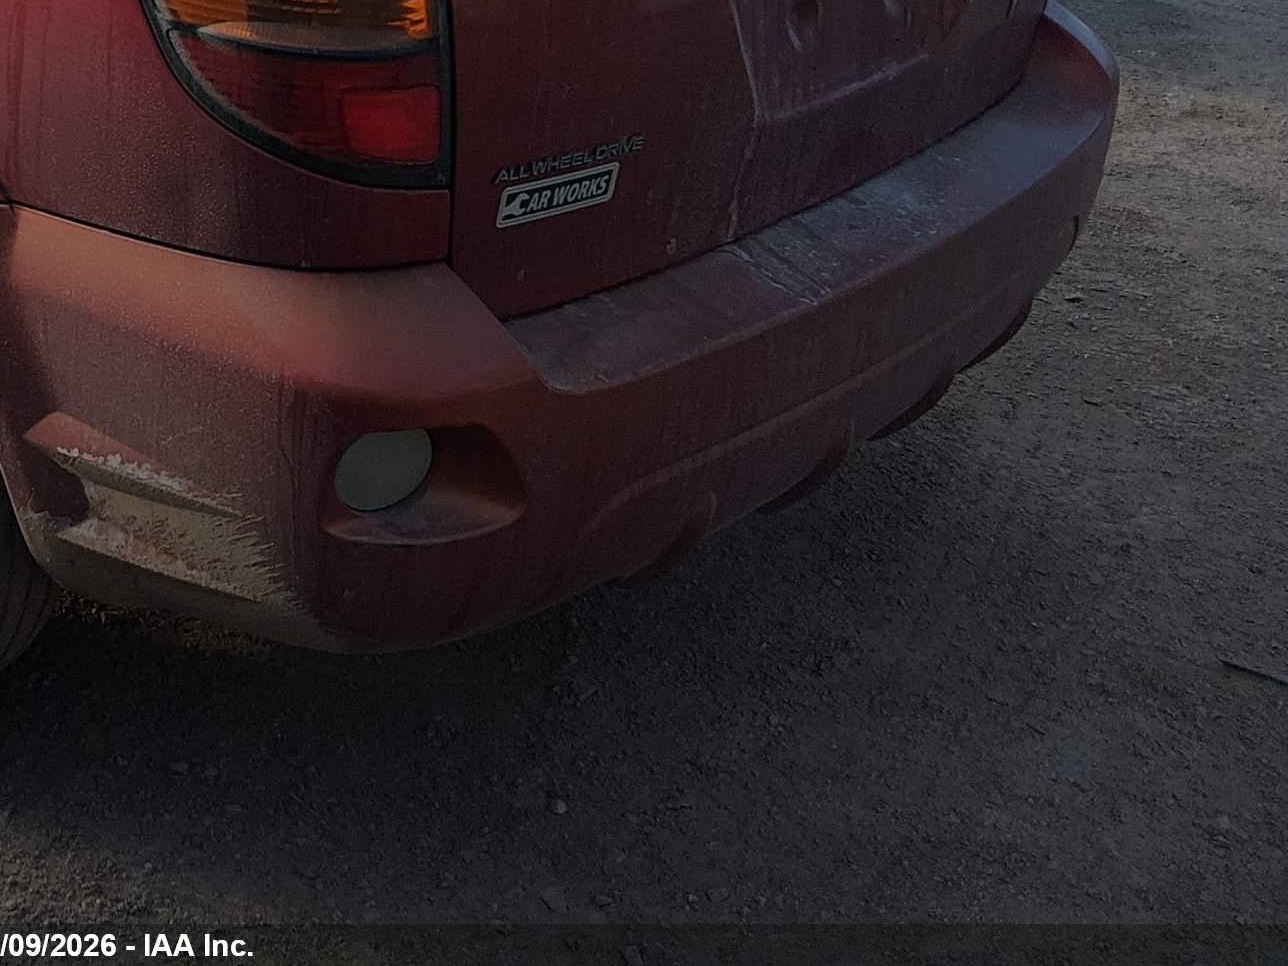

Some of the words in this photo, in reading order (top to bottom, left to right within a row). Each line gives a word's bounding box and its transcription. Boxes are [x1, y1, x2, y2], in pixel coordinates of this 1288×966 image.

[495, 167, 532, 183] ALL
[532, 152, 593, 176] WHEEL
[596, 134, 646, 161] DRIVE
[552, 175, 609, 205] WORKS
